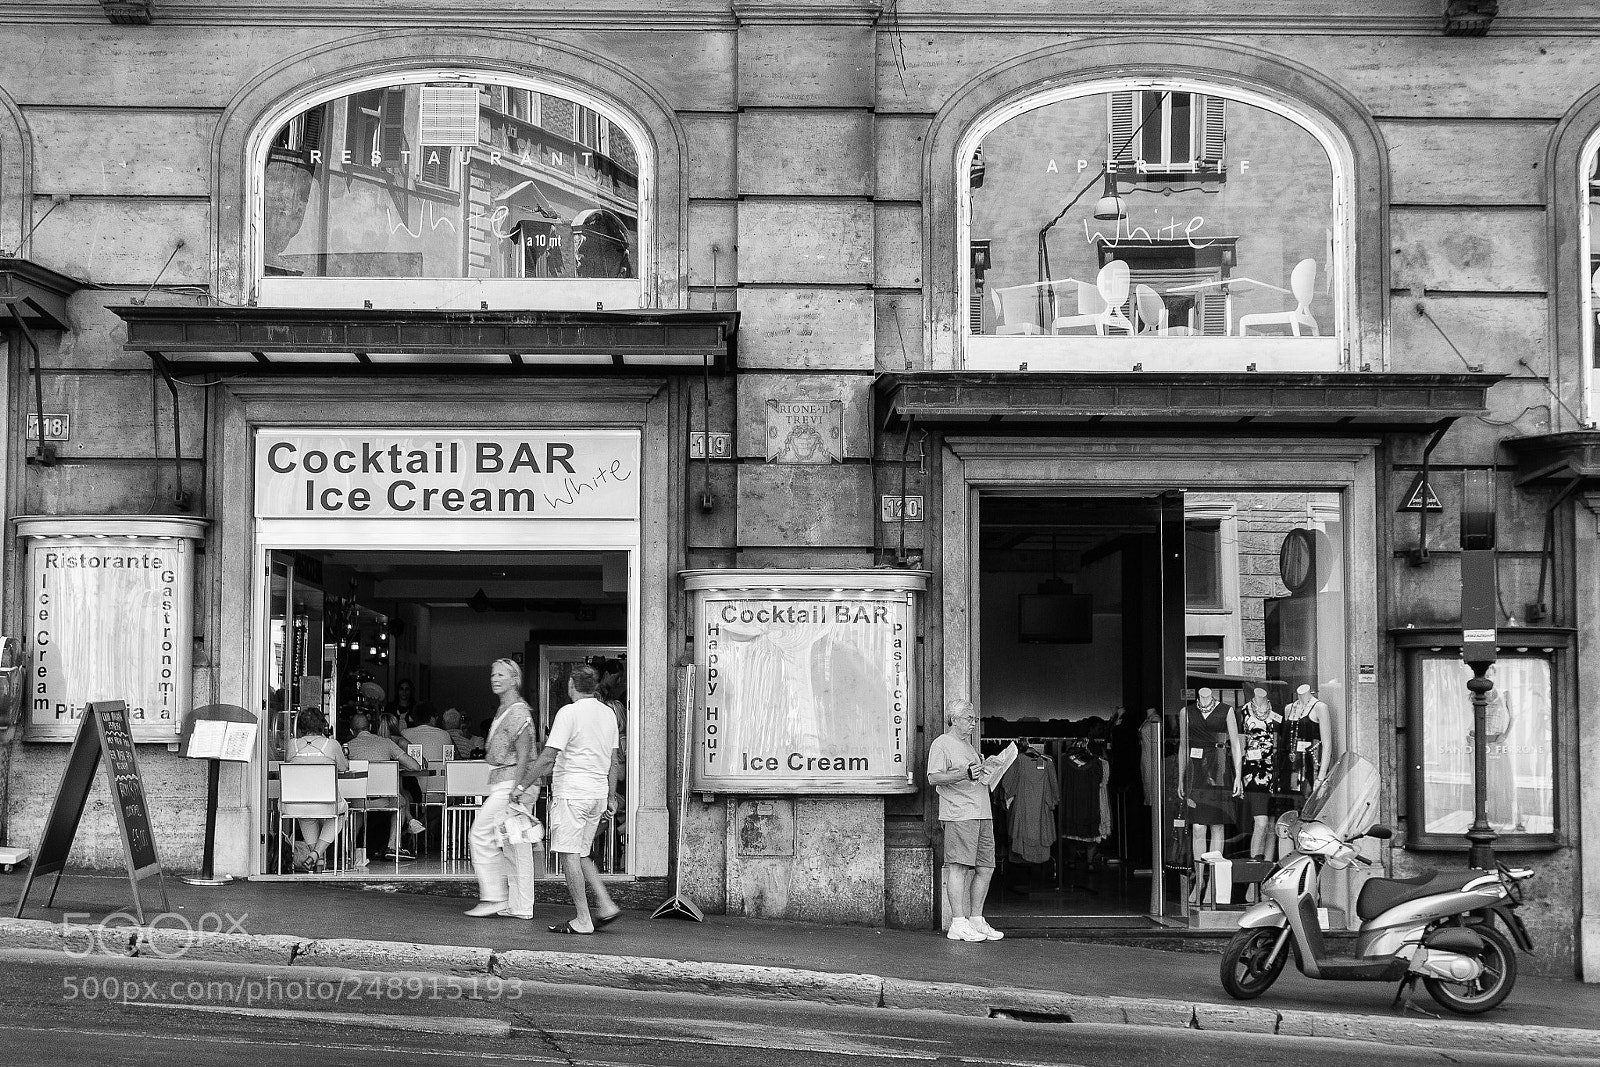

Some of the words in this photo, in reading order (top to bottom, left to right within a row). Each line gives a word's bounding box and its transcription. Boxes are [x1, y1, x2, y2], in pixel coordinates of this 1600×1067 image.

[310, 150, 592, 166] RESTAURANT
[1046, 159, 1250, 175] APERITIF
[386, 199, 521, 239] Whte
[527, 237, 533, 247] a
[535, 234, 546, 247] 10
[548, 235, 562, 247] mt
[34, 418, 63, 436] 118
[786, 415, 823, 424] TREVI
[697, 435, 726, 455] 119
[267, 441, 458, 474] Cocktail
[475, 442, 577, 474] BAR
[305, 480, 371, 512] Ice
[386, 480, 535, 512] Cream
[45, 553, 163, 569] Ristorante
[38, 573, 49, 621] Ice
[721, 605, 826, 624] Cocktail
[835, 605, 889, 624] BAR
[158, 570, 175, 720] Gastronomia
[707, 622, 720, 696] Happy
[33, 630, 49, 710] Cream
[892, 623, 903, 764] Pasticceria
[55, 703, 145, 720] Pizia
[706, 706, 719, 763] Hour
[742, 752, 779, 771] Ice
[787, 752, 869, 771] Cream
